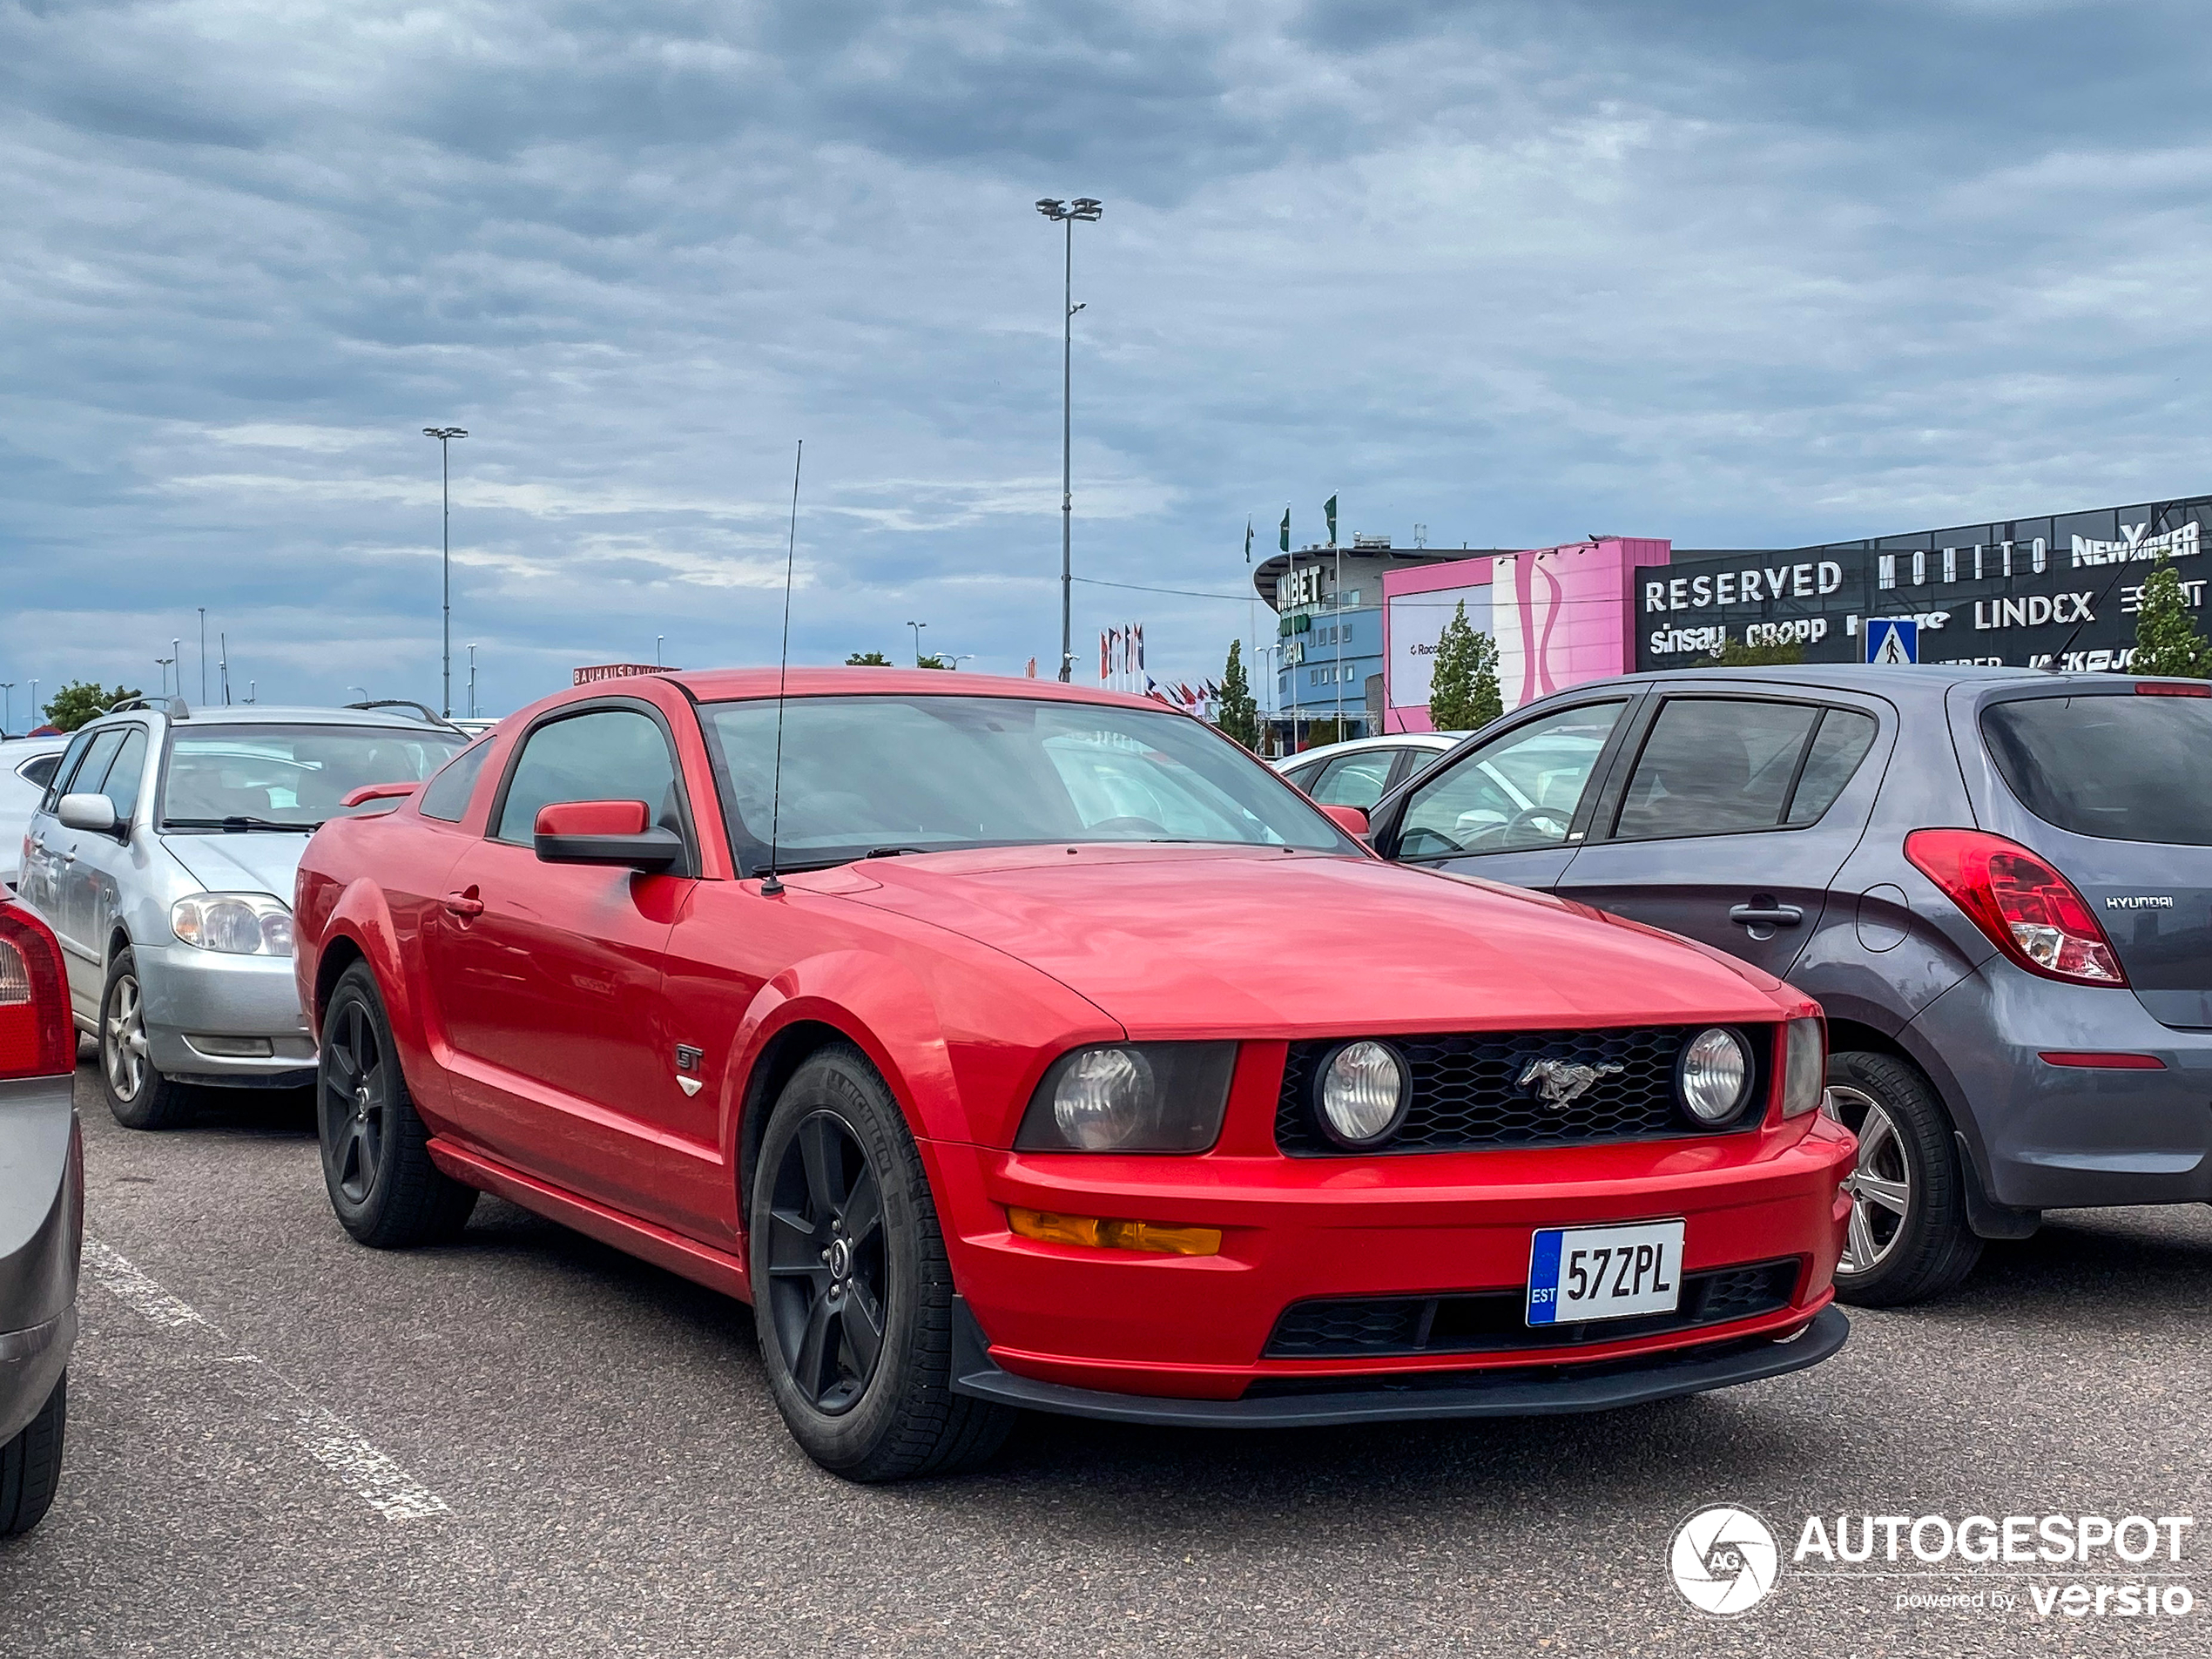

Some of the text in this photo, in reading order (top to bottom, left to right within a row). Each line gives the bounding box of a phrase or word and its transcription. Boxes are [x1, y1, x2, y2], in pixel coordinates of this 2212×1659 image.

[1878, 537, 2047, 590] MOHITO
[1646, 561, 1842, 612] RESERVED
[1974, 591, 2095, 630] LINDEX
[1650, 623, 1726, 658] sinsay
[574, 666, 624, 683] BAUHAUS
[2106, 896, 2174, 908] HYUNDAI
[1568, 1244, 1670, 1300] 57ZPL
[1531, 1288, 1556, 1304] EST
